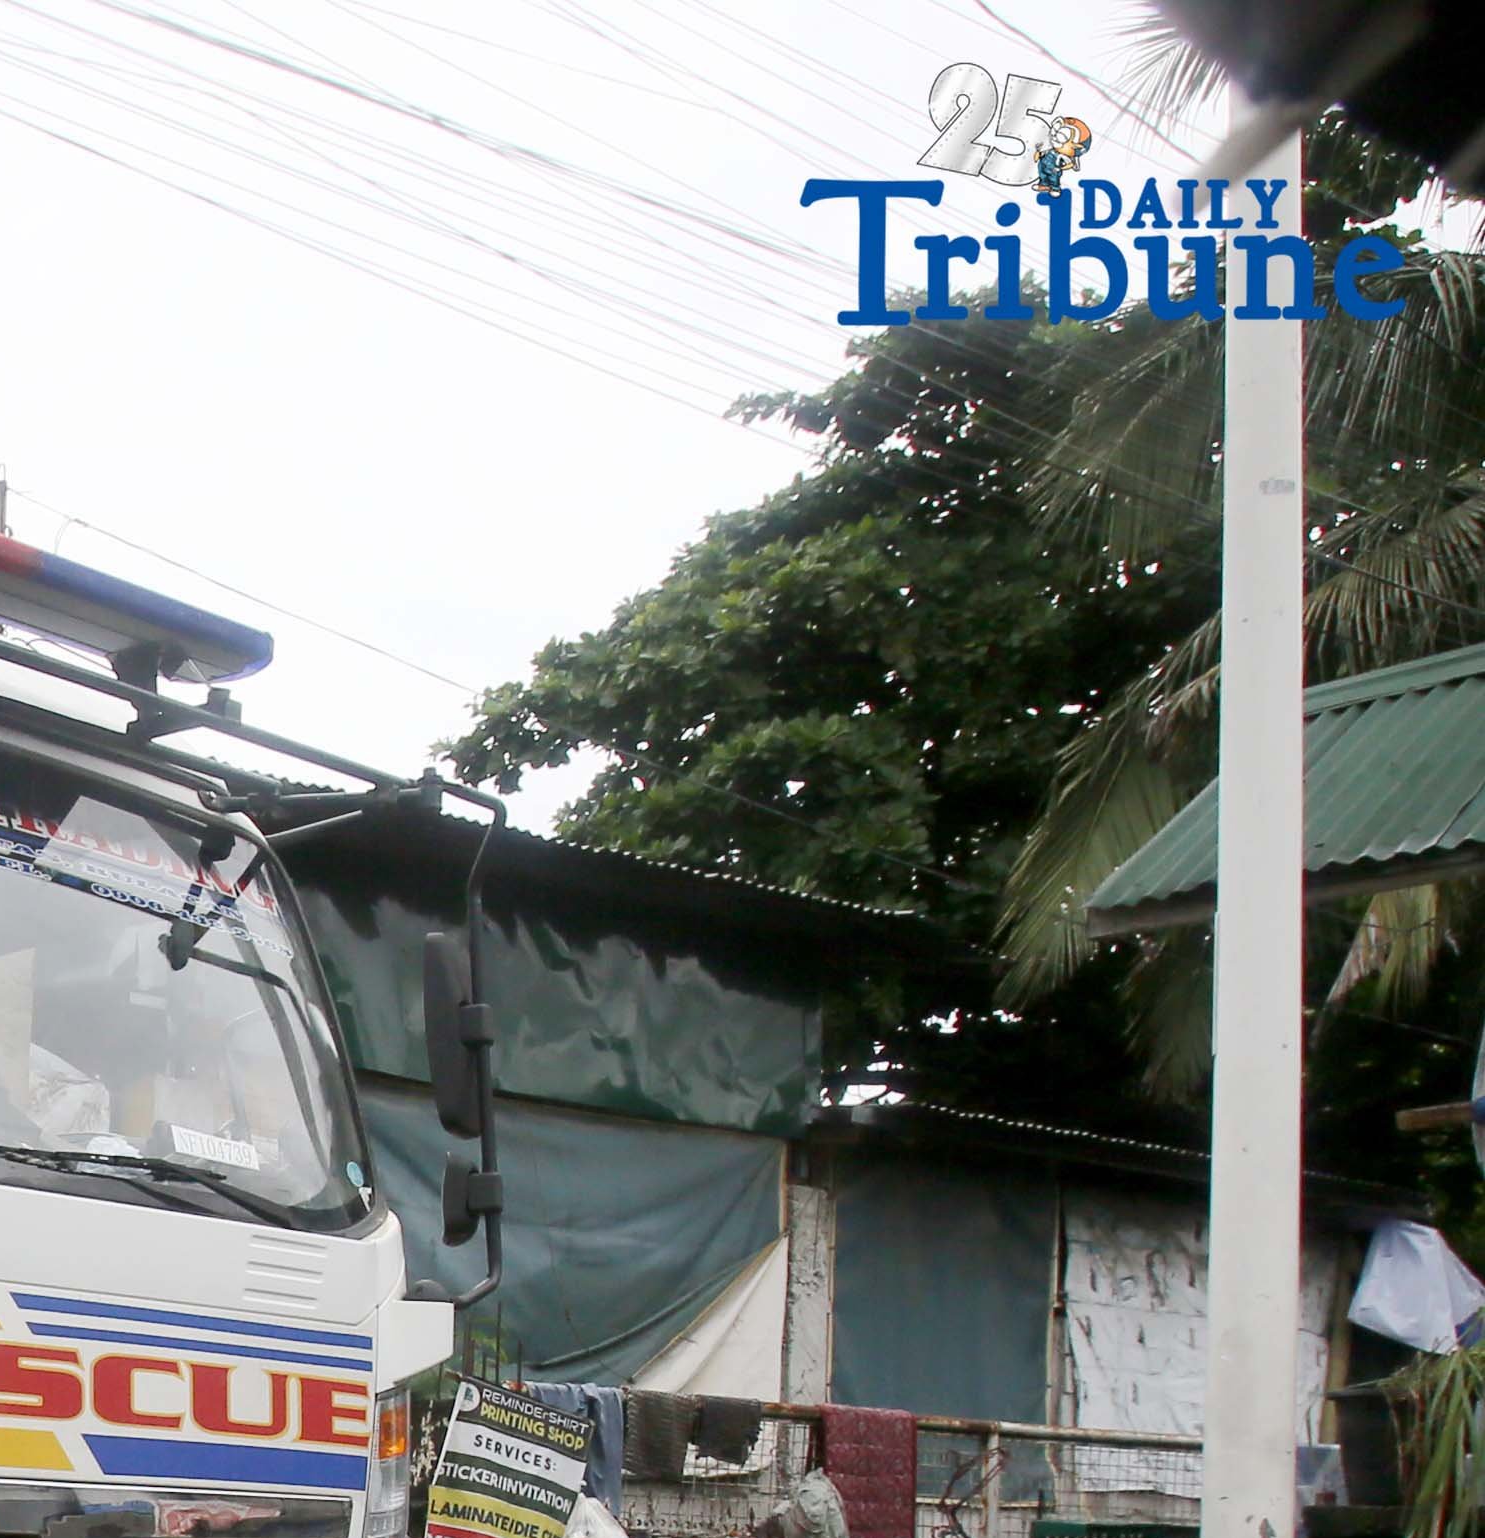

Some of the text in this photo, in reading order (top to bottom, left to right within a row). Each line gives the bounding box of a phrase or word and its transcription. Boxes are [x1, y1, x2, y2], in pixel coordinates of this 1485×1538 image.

[480, 1402, 585, 1451] PRINTING SHOP
[473, 1434, 557, 1471] SERVICES:
